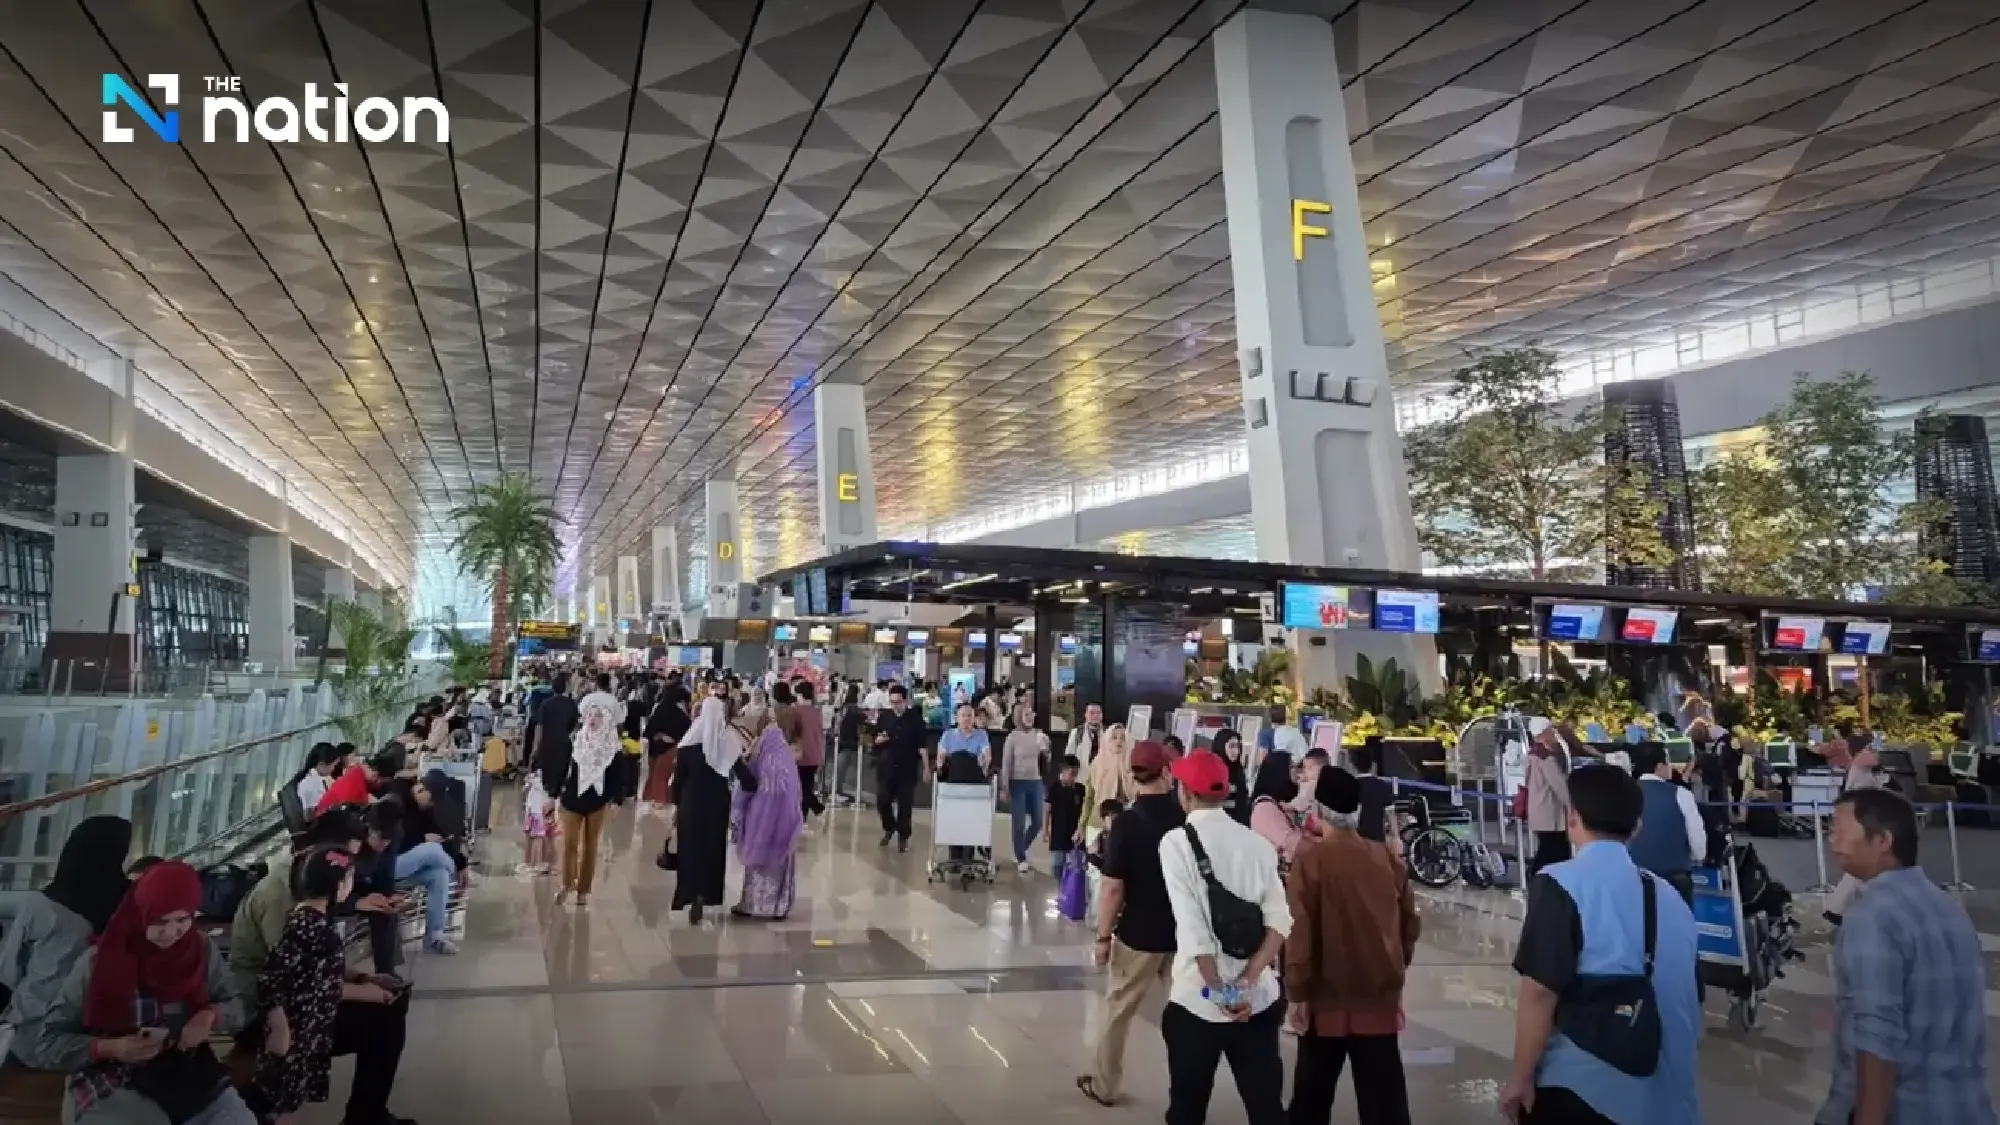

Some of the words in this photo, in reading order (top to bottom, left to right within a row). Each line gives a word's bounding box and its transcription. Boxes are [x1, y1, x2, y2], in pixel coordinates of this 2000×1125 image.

[1291, 199, 1333, 262] F
[838, 474, 858, 502] E
[719, 542, 733, 559] D
